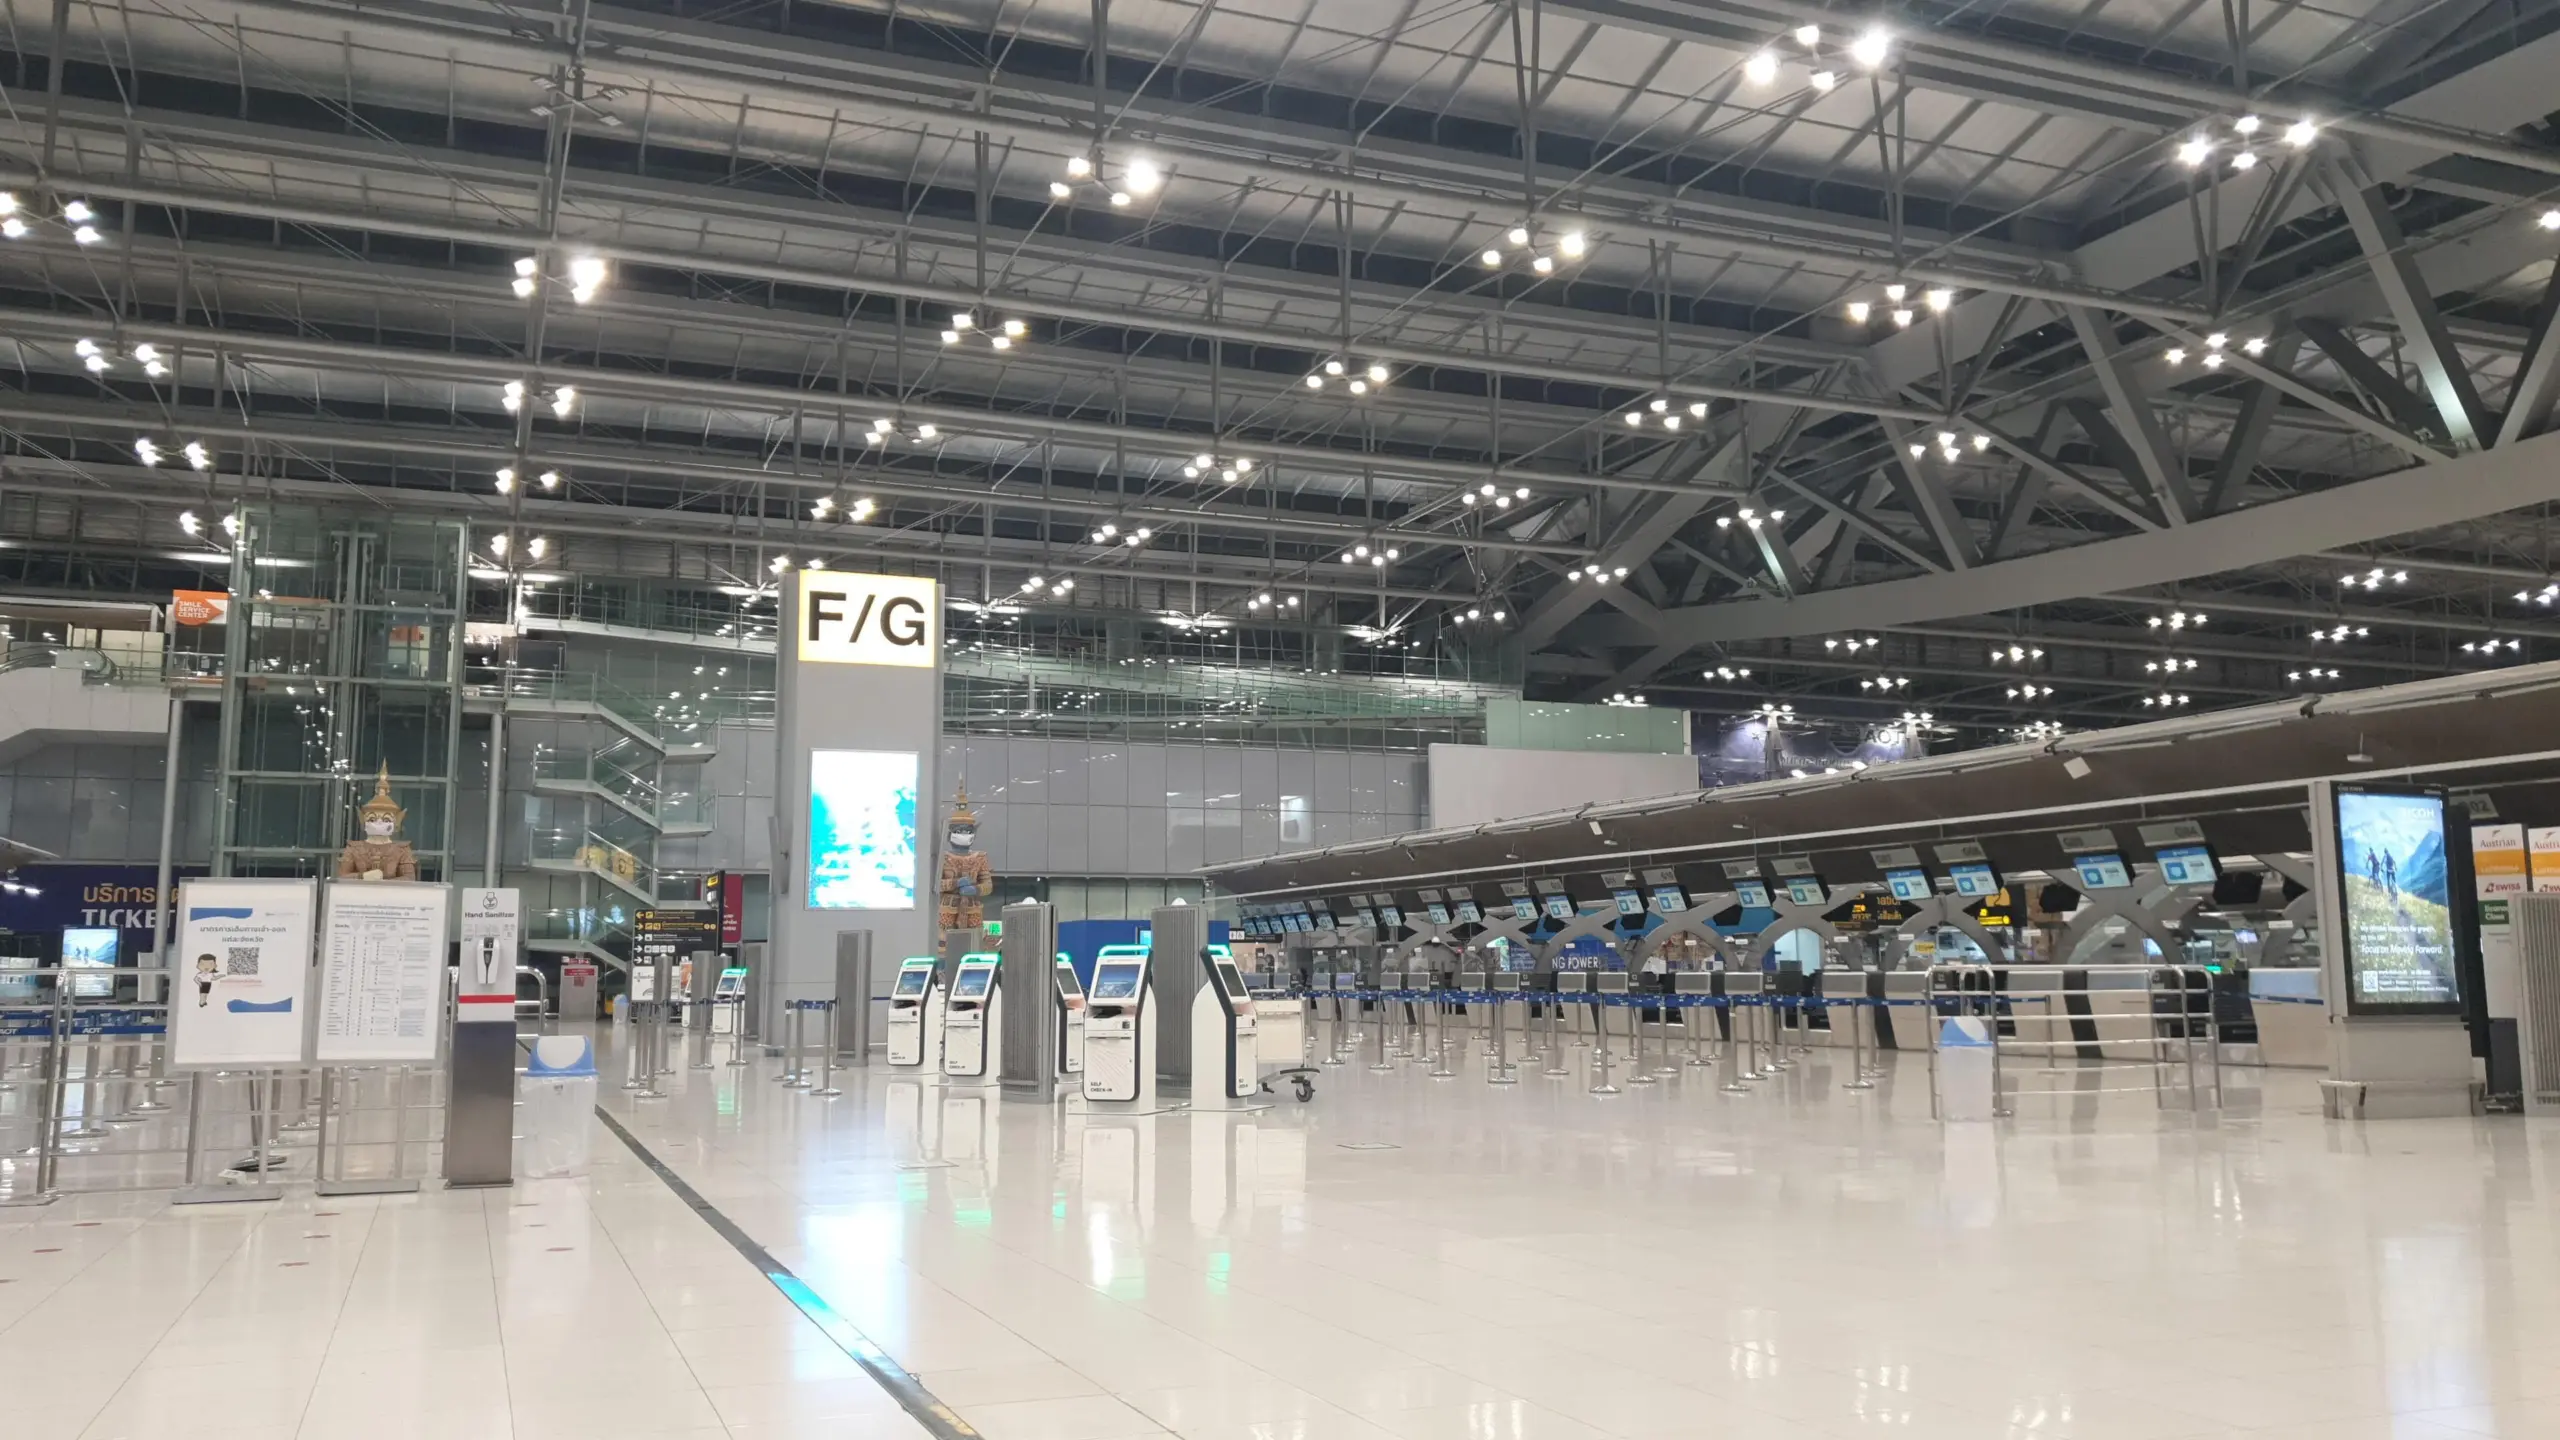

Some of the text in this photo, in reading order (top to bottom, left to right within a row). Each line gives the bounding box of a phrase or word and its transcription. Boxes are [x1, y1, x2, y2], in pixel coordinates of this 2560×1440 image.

[178, 600, 202, 608] SMILE
[178, 606, 211, 614] SERVICE
[808, 590, 925, 647] F/G
[2480, 839, 2516, 848] Austrian
[2495, 882, 2521, 891] SWISS
[1567, 956, 1599, 969] POWER
